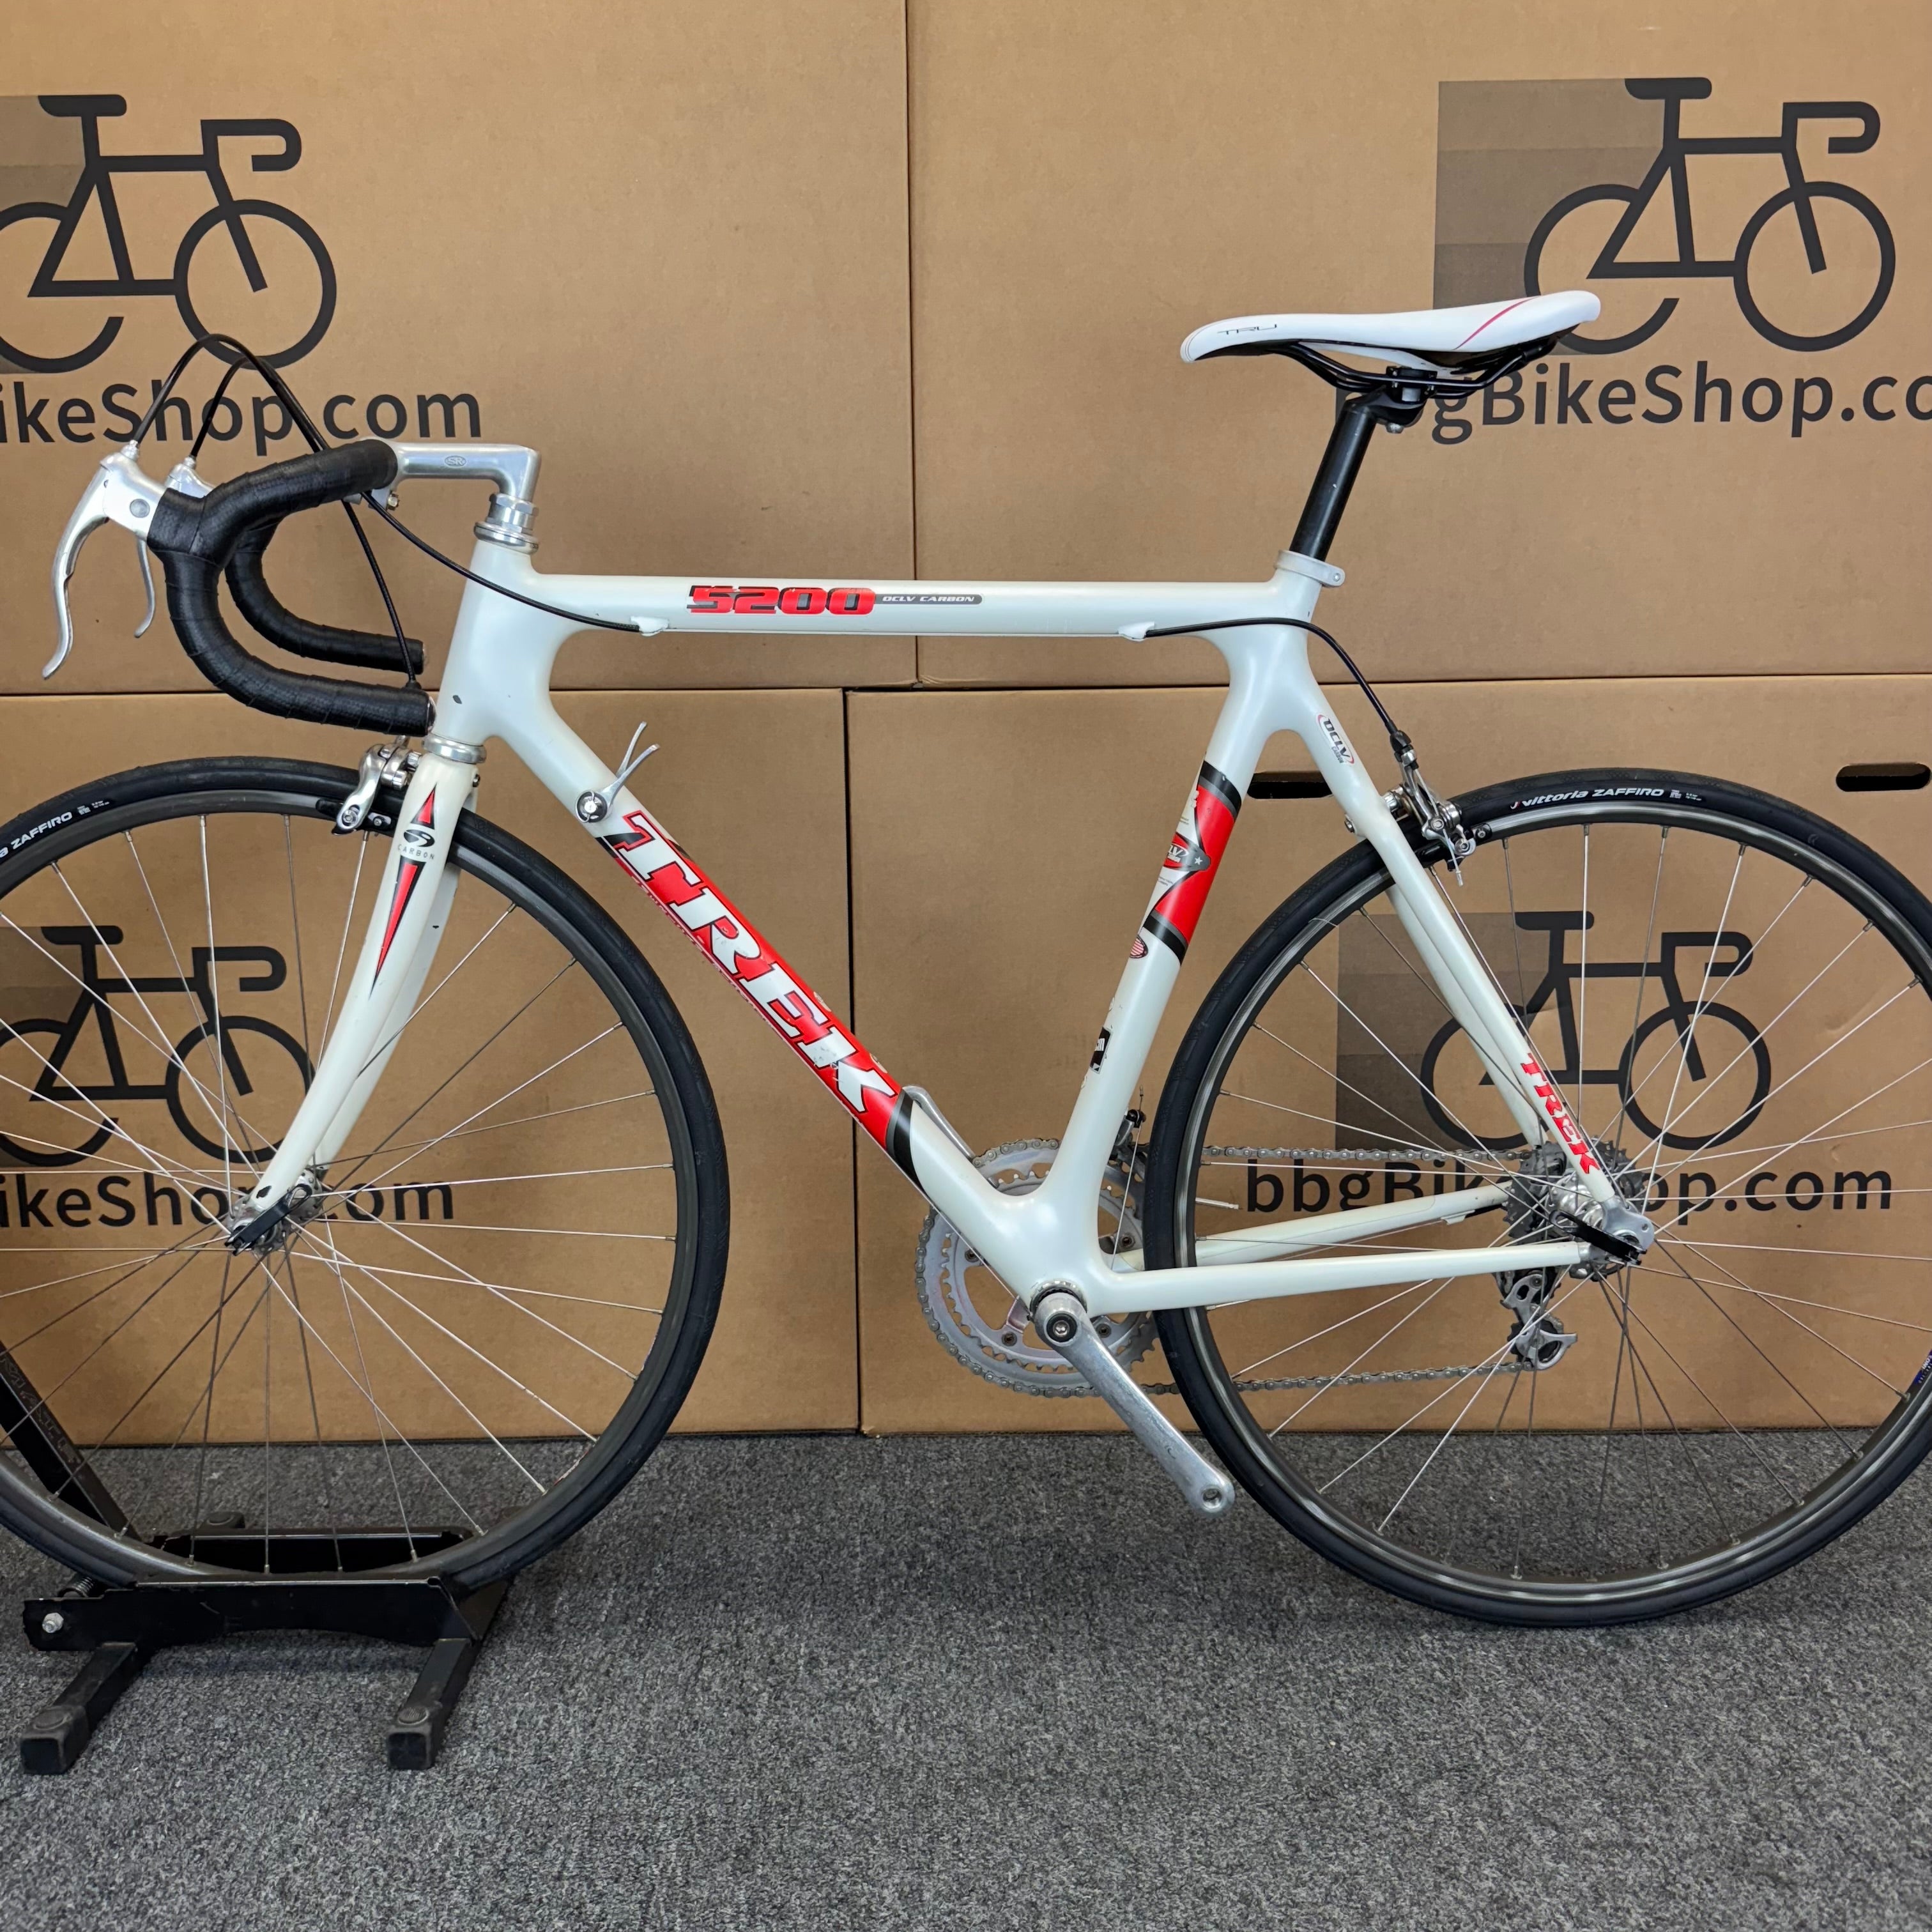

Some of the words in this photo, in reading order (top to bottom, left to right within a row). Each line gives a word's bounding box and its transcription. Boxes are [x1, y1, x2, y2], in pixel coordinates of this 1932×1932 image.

[0, 379, 481, 456] keShopcom
[1335, 360, 1932, 444] gBikeShop.co
[686, 585, 875, 615] 5200
[1323, 718, 1350, 758] OCLV
[1592, 788, 1664, 797] ZAFFIRO
[11, 811, 73, 850] ZAFFIRO
[397, 843, 435, 860] CARBON
[615, 810, 898, 1113] TREK
[1521, 1052, 1600, 1174] TREK
[0, 1172, 454, 1227] ikeShoom
[1247, 1158, 1891, 1225] bbgBikop.com
